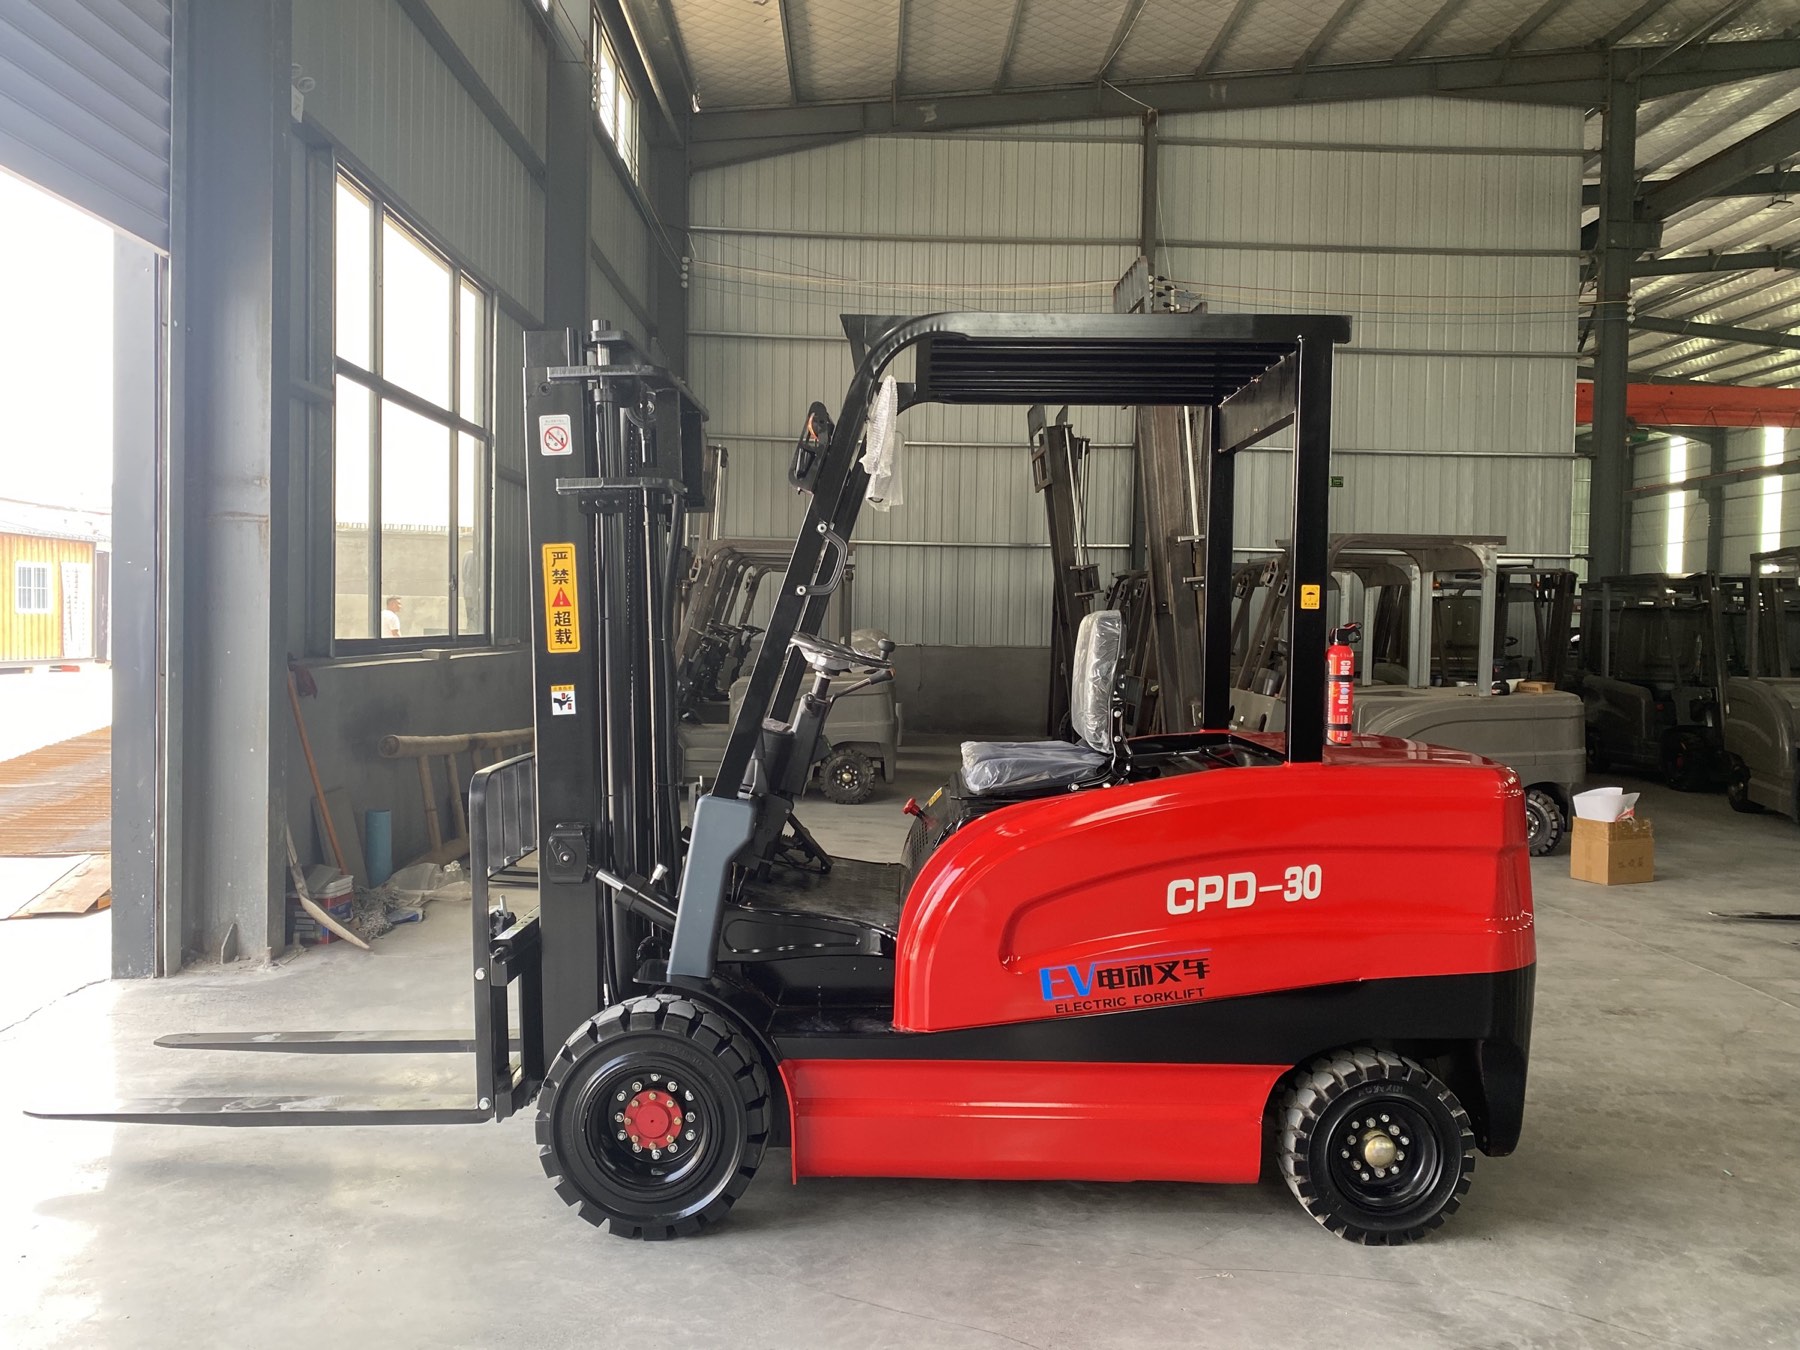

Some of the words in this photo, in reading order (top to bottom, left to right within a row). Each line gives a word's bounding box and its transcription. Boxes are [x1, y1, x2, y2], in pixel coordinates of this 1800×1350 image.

[1166, 863, 1322, 915] CPD-30
[1055, 997, 1128, 1013] ELECTRIC
[1134, 987, 1205, 1005] FORKLIFT
